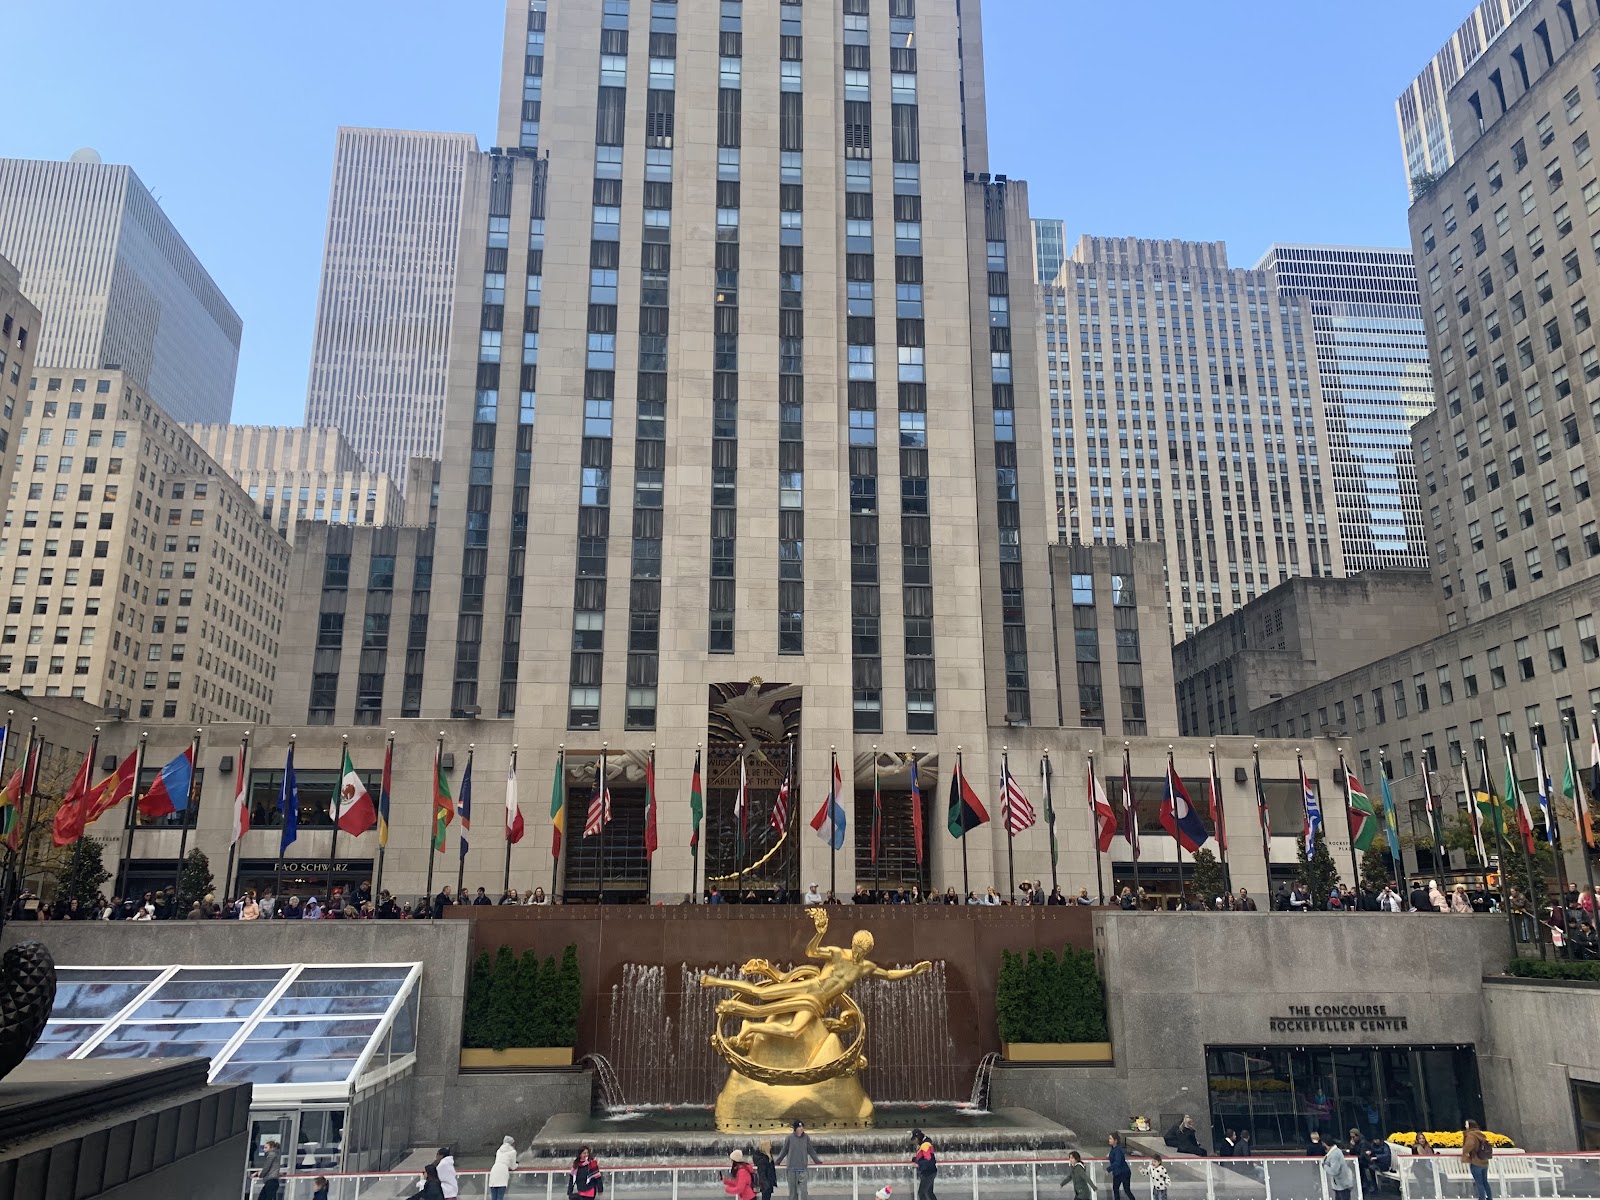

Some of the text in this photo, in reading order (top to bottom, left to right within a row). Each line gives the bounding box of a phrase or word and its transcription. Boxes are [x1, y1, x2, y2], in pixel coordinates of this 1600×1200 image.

[730, 768, 774, 776] SHL BE THE
[756, 777, 770, 786] THY
[300, 863, 348, 871] SCHWRZ
[1288, 1005, 1387, 1016] THE CONCOURSE
[1269, 1020, 1408, 1032] ROCKEFELLER CENTER
